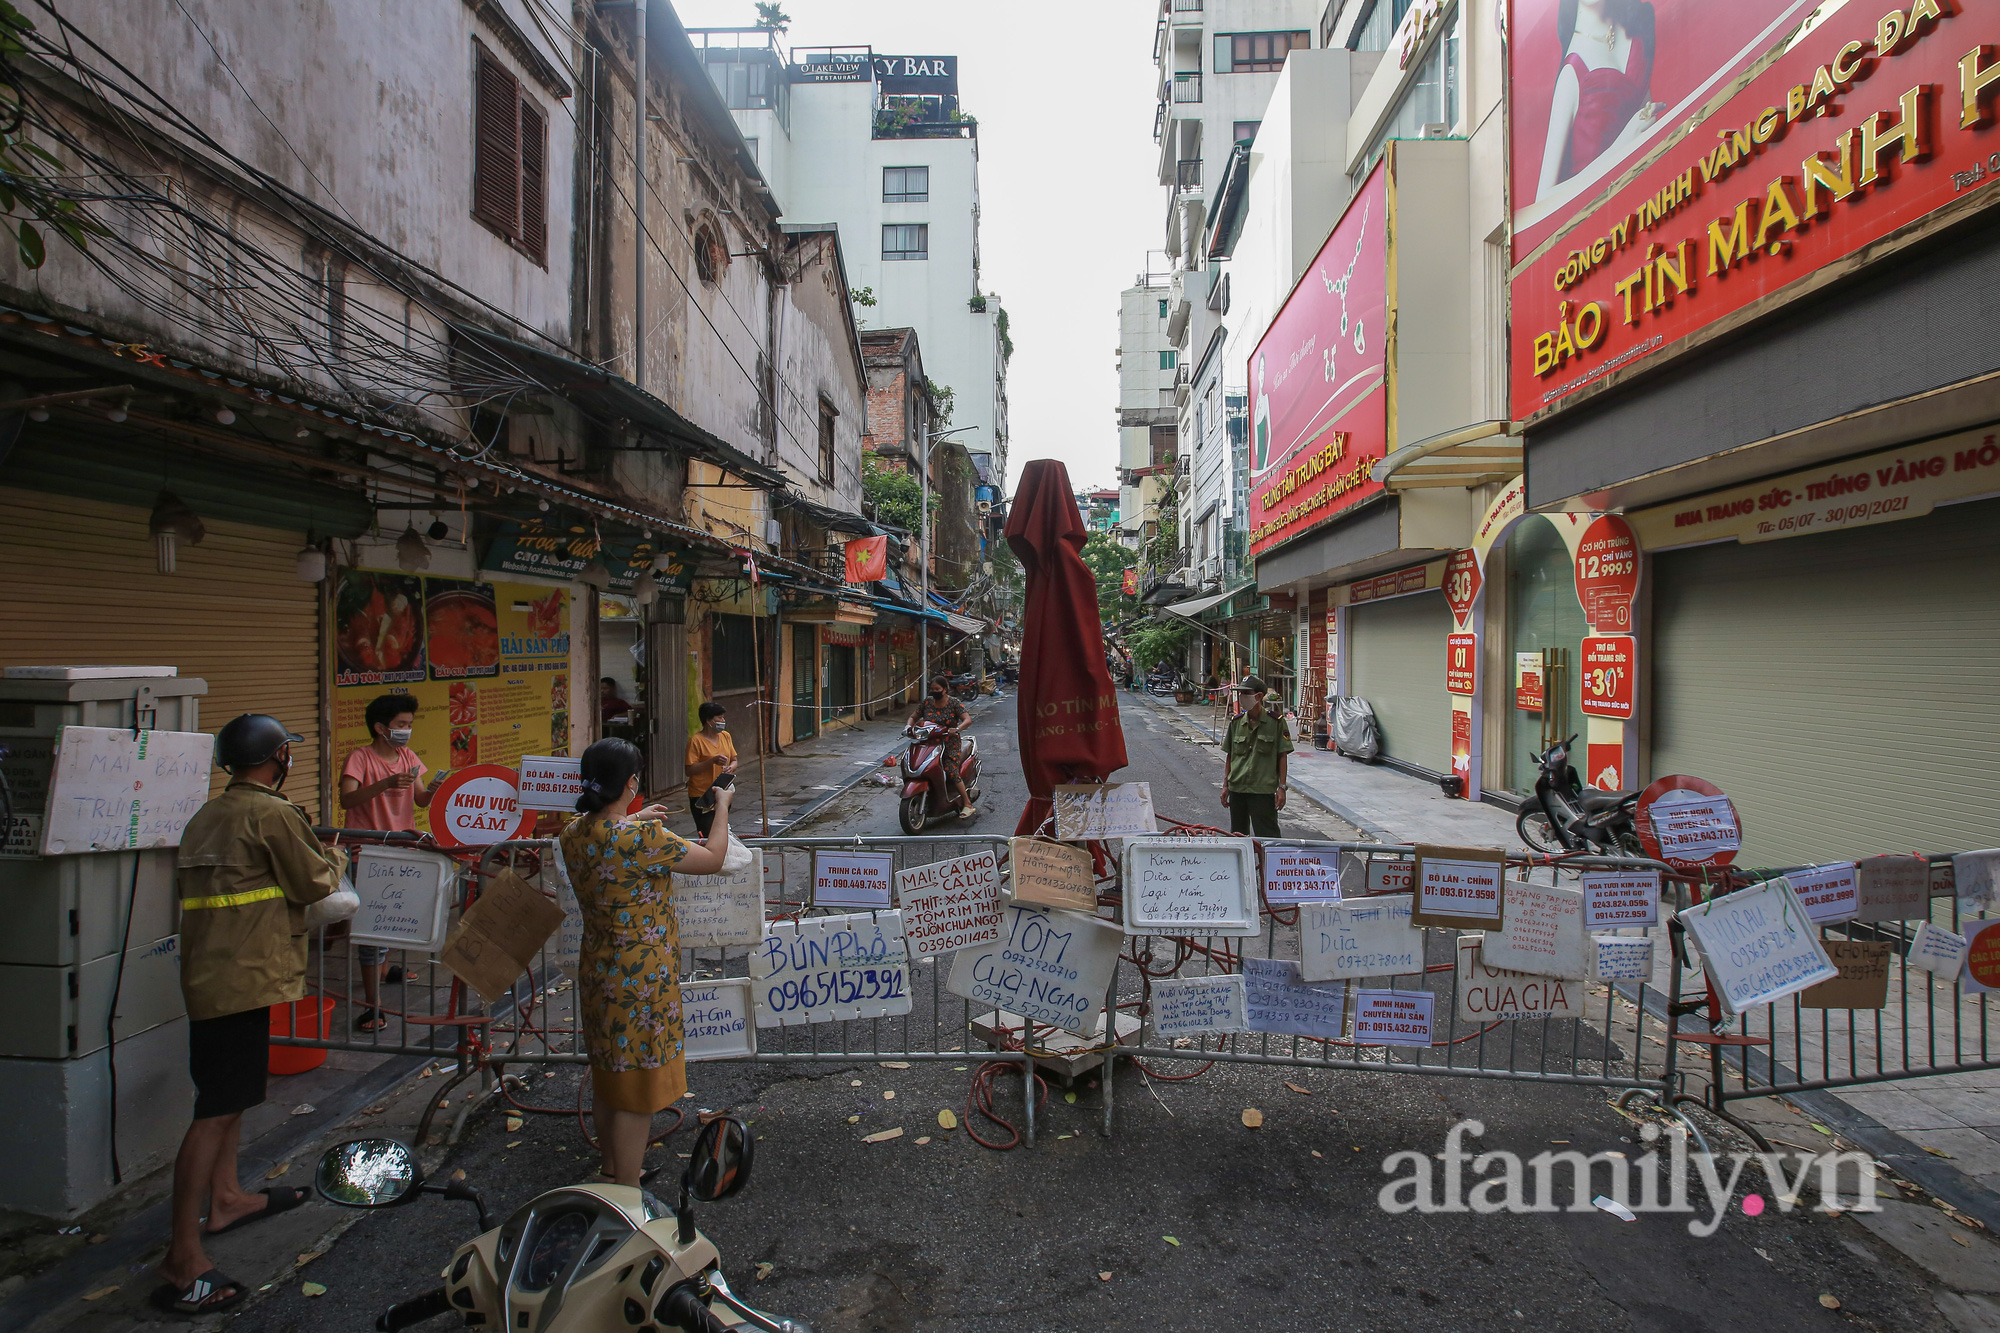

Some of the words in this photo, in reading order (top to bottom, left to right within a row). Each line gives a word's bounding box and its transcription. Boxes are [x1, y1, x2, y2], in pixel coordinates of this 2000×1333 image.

[801, 63, 834, 73] O'LAKE
[836, 63, 860, 72] VIEW
[903, 57, 949, 77] BAR
[1554, 238, 1606, 292] CÔNG
[1610, 216, 1637, 253] TY
[1637, 167, 1694, 233] TNHH
[1700, 107, 1777, 184] VÀNG
[1787, 40, 1863, 124] BẠC
[1950, 162, 1986, 191] Tel:
[1534, 300, 1602, 377] BẢO
[1615, 240, 1689, 325] TÍN
[1706, 85, 1920, 277] MẠNH
[1261, 484, 1281, 512] TRUNG
[1281, 472, 1296, 498] TÂM
[1325, 432, 1346, 467] BÀY
[1674, 509, 1703, 528] MUA
[1706, 498, 1755, 522] TRANG
[1758, 487, 1793, 511] SỨC
[1805, 473, 1872, 501] TRÚNG
[1876, 456, 1947, 487] VÀNG
[1481, 521, 1491, 538] MUA
[1490, 501, 1506, 522] TRANG
[1506, 489, 1518, 503] SỨC
[1777, 512, 1816, 532] 05/07
[1825, 495, 1910, 524] 30/09/2021
[1582, 541, 1592, 552] CƠ
[1593, 539, 1606, 551] HỘI
[1607, 536, 1629, 549] TRÚNG
[1578, 556, 1600, 579] 12
[1602, 551, 1614, 562] CHỈ
[1614, 549, 1633, 561] VÀNG
[1601, 561, 1633, 577] 999.9
[500, 631, 523, 654] HẢI
[526, 632, 548, 654] SẢN
[1596, 643, 1606, 653] TRỢ
[1607, 642, 1616, 651] GIÁ
[1455, 648, 1466, 668] 01
[1597, 654, 1614, 662] TRANG
[1615, 653, 1627, 662] SỨC
[155, 752, 198, 777] BÁN
[539, 770, 555, 779] LÂN
[522, 782, 534, 792] ĐT:
[454, 793, 486, 809] KHU
[490, 796, 517, 815] VỰC
[456, 812, 508, 831] CẤM
[1678, 828, 1735, 844] 0912.643.712
[1150, 853, 1176, 867] Kim
[1299, 856, 1321, 866] NGHĨA
[852, 866, 862, 876] CÁ
[864, 868, 878, 876] KHO
[902, 868, 937, 889] MAI:
[939, 860, 961, 879] CÁ
[963, 856, 994, 872] KHO
[1276, 868, 1304, 877] CHUYÊN
[1317, 869, 1326, 877] TA
[1442, 873, 1459, 883] LÂN
[818, 878, 831, 888] ĐT:
[833, 878, 887, 890] 090.449.7435
[943, 874, 964, 891] CÁ
[967, 870, 994, 887] LỤC
[1268, 881, 1281, 891] ĐT:
[1382, 875, 1413, 886] STO
[1811, 883, 1824, 893] TÉP
[1825, 880, 1839, 889] KIM
[945, 888, 970, 906] XÁ
[1425, 885, 1438, 896] ĐT:
[1440, 886, 1496, 900] 093.612.9598
[1805, 889, 1855, 907] 034.682.9999
[915, 910, 946, 925] TÔM
[974, 899, 1001, 913] THỊT
[1592, 900, 1649, 909] 0243.824.0596
[1595, 910, 1647, 920] 0914.572.959
[919, 928, 999, 953] 0396011443
[1008, 905, 1072, 963] TÔM
[1373, 1000, 1393, 1008] MINH
[1363, 1010, 1392, 1019] CHUYÊN
[1358, 1021, 1371, 1031] ĐT:
[1373, 1022, 1428, 1035] 0915.432.675
